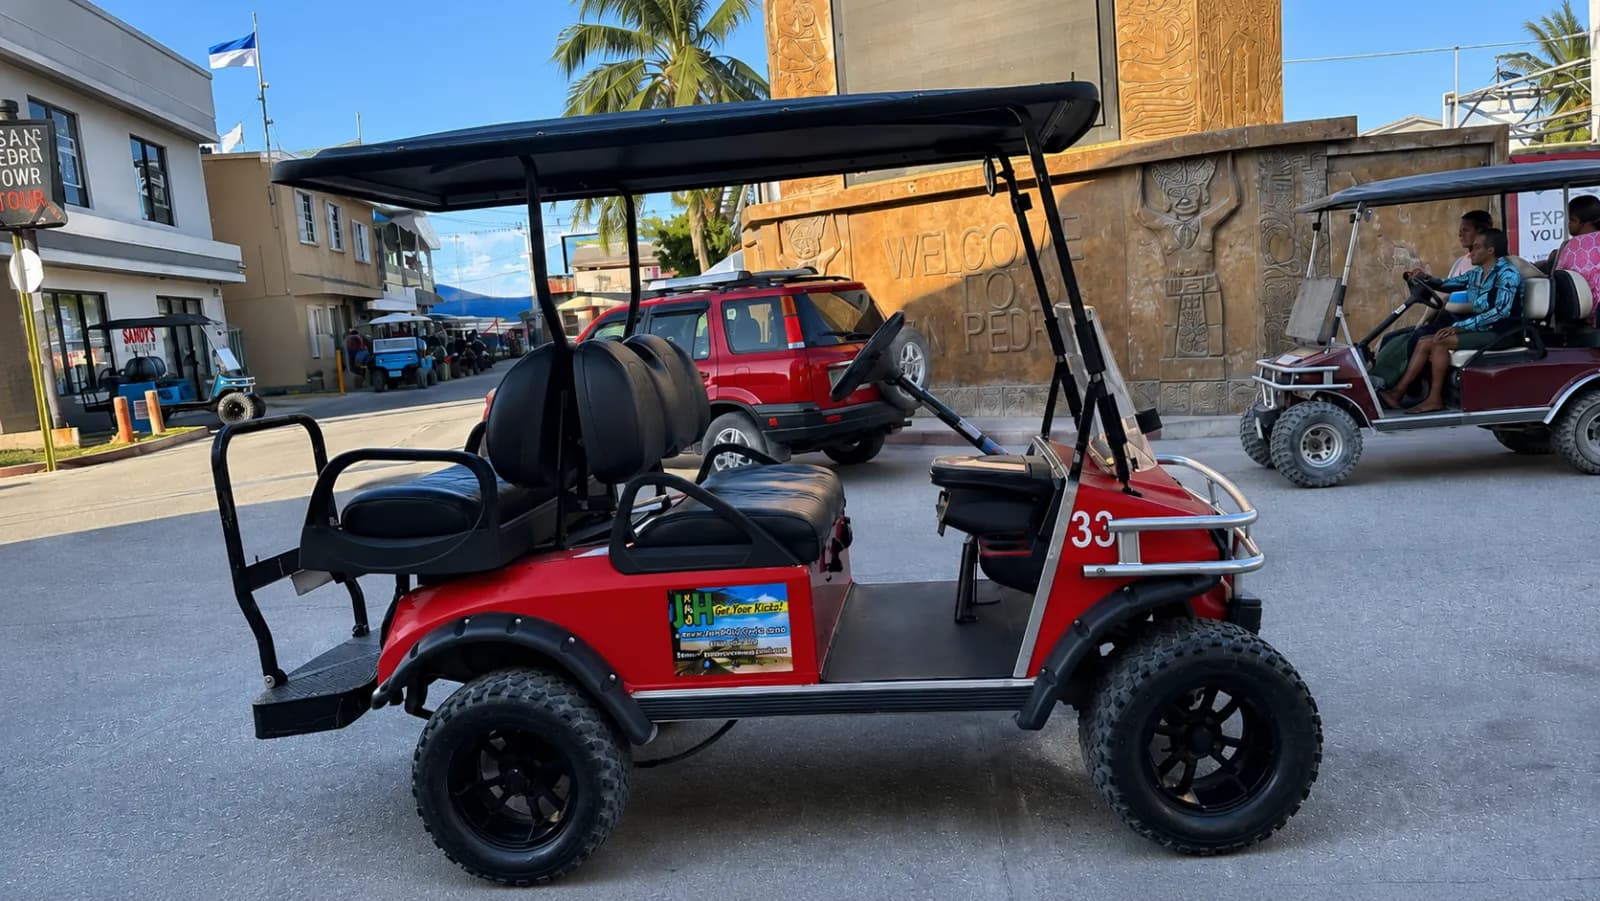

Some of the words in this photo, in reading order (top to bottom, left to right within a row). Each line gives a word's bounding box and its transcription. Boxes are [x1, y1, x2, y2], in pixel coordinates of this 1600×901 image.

[961, 270, 1016, 313] TO
[963, 306, 1049, 354] PEDR
[1071, 510, 1116, 549] 33
